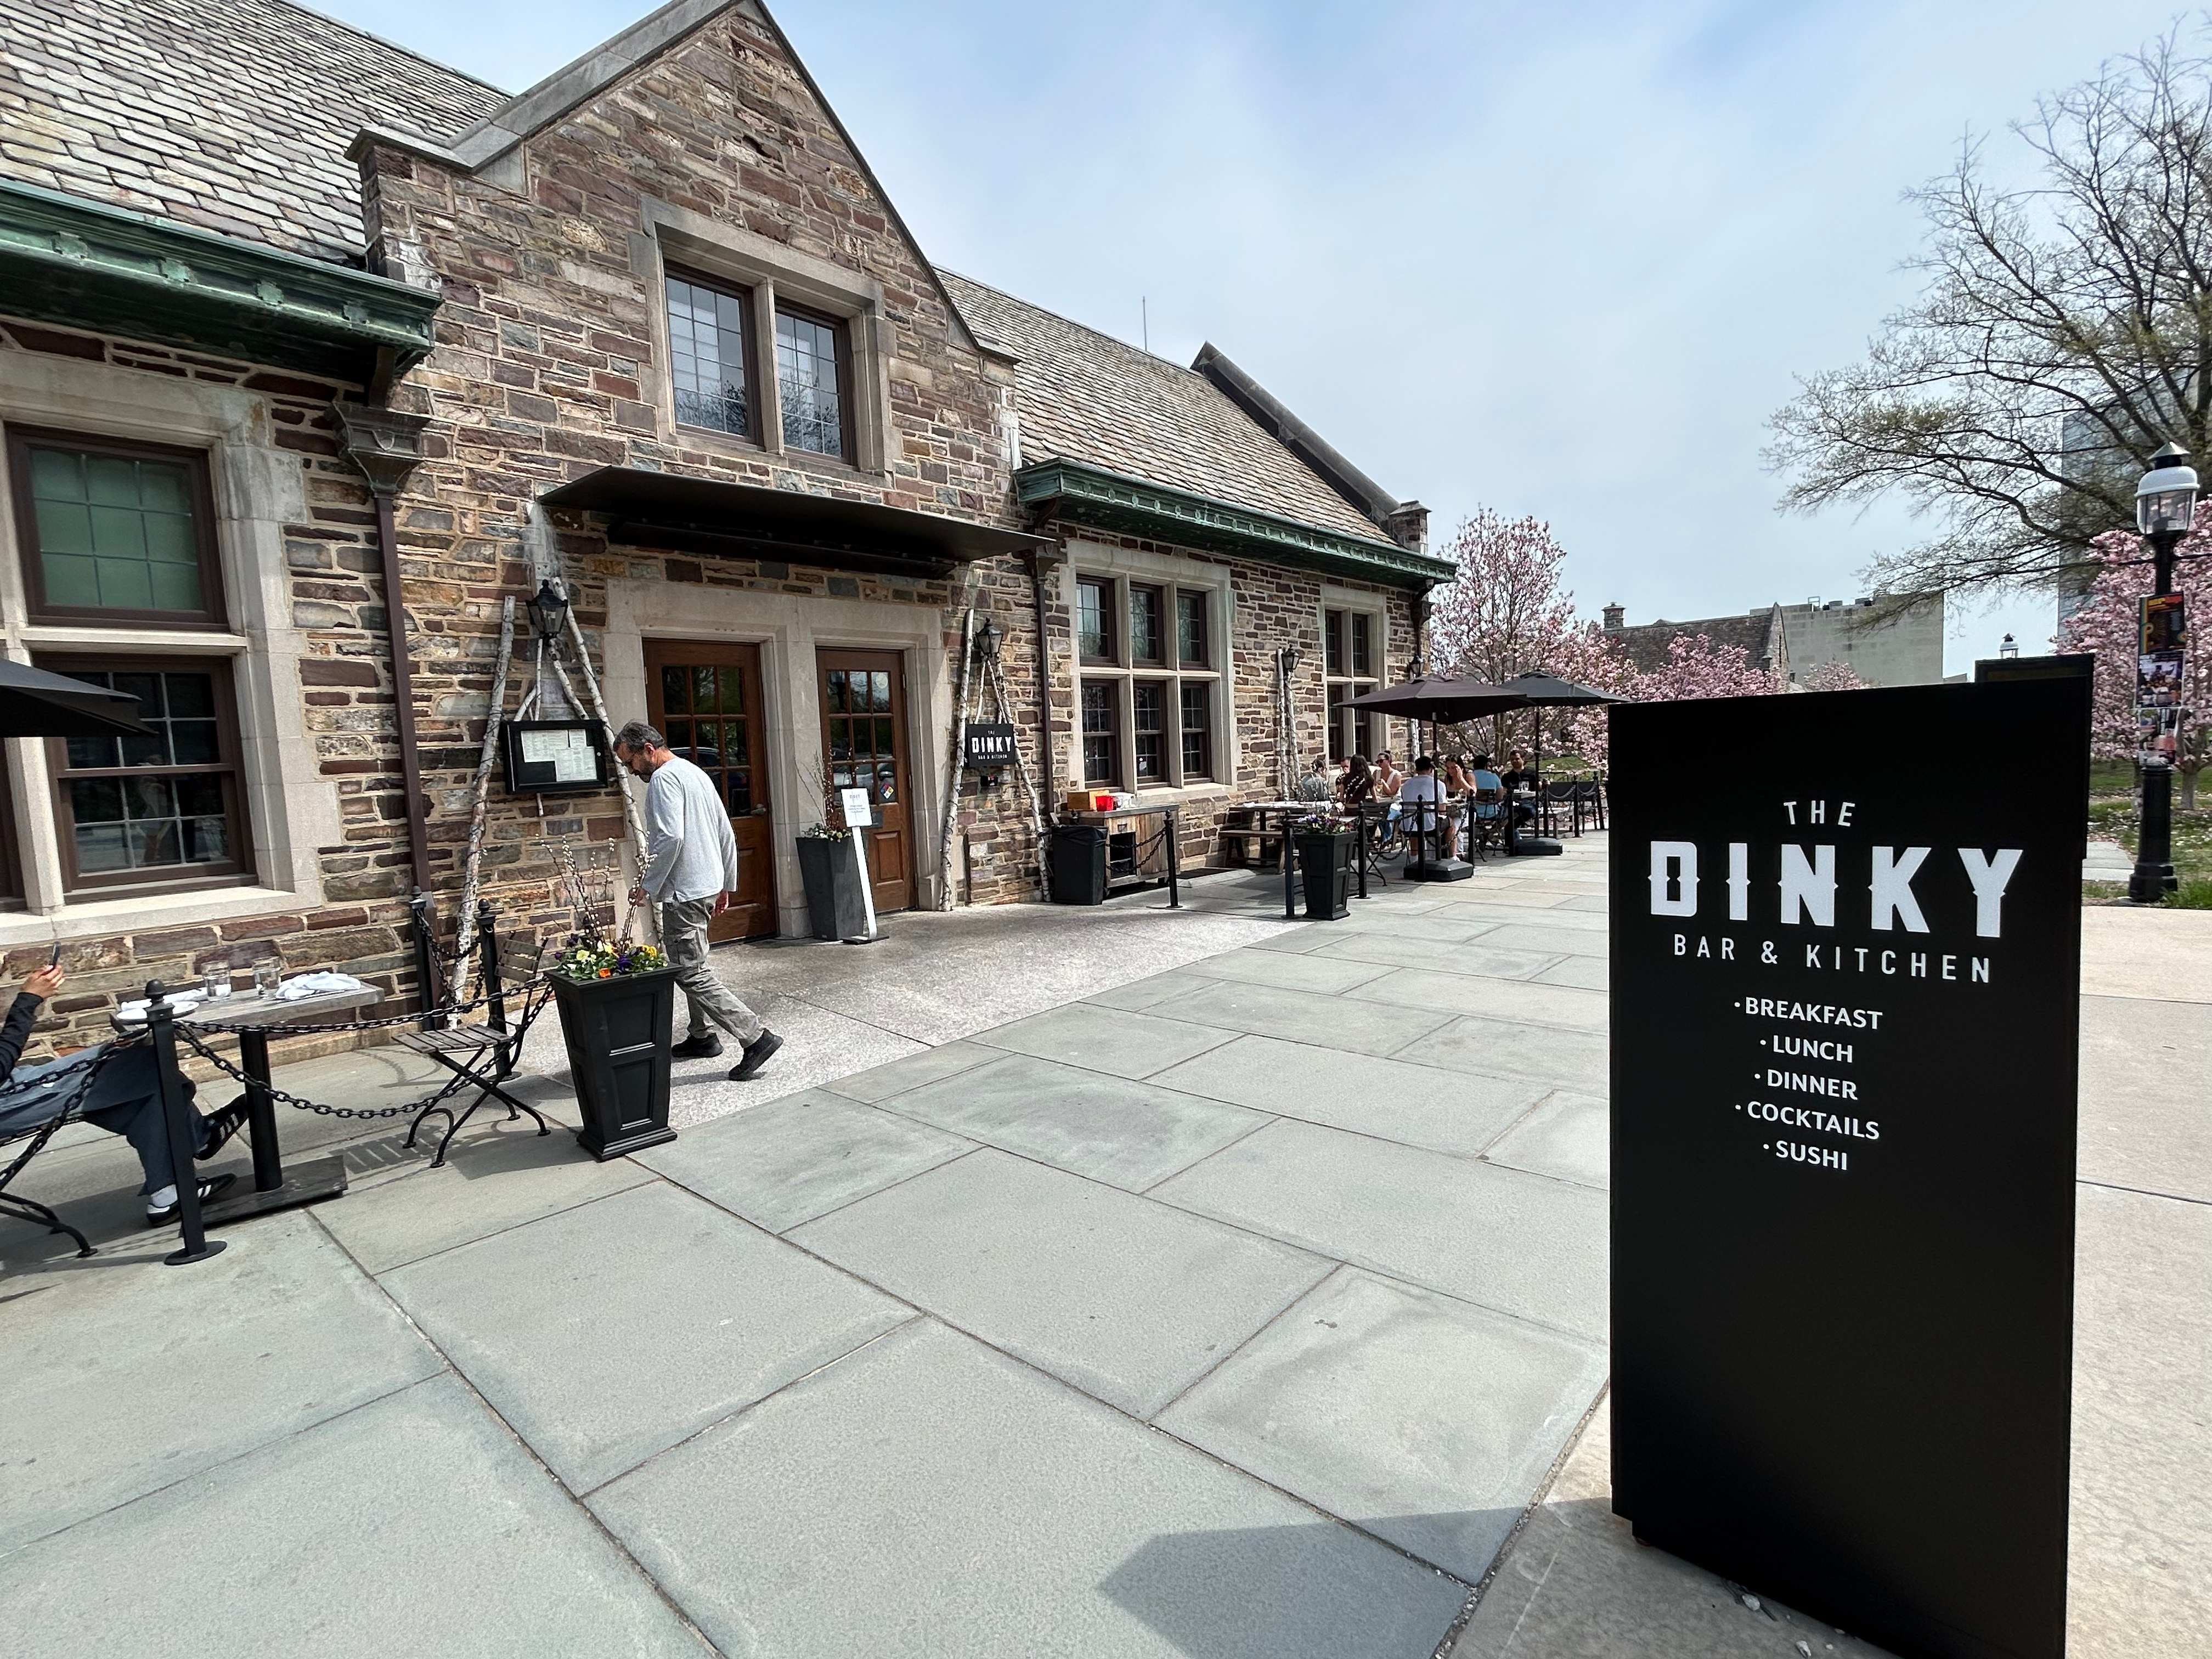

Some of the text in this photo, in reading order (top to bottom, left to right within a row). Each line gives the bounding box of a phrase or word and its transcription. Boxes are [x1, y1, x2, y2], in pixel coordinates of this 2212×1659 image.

[971, 736, 1012, 753] DINKY
[1782, 799, 1856, 827] THE
[1646, 840, 2024, 939] DINKY
[1674, 933, 1990, 984] BAR & KITCHEN
[1745, 996, 1883, 1030] BREAKFAST
[1773, 1034, 1853, 1064] LUNCH
[1767, 1068, 1859, 1101] DINNER
[1747, 1101, 1880, 1141] COCKTAILS
[1775, 1139, 1848, 1171] SUSHI
